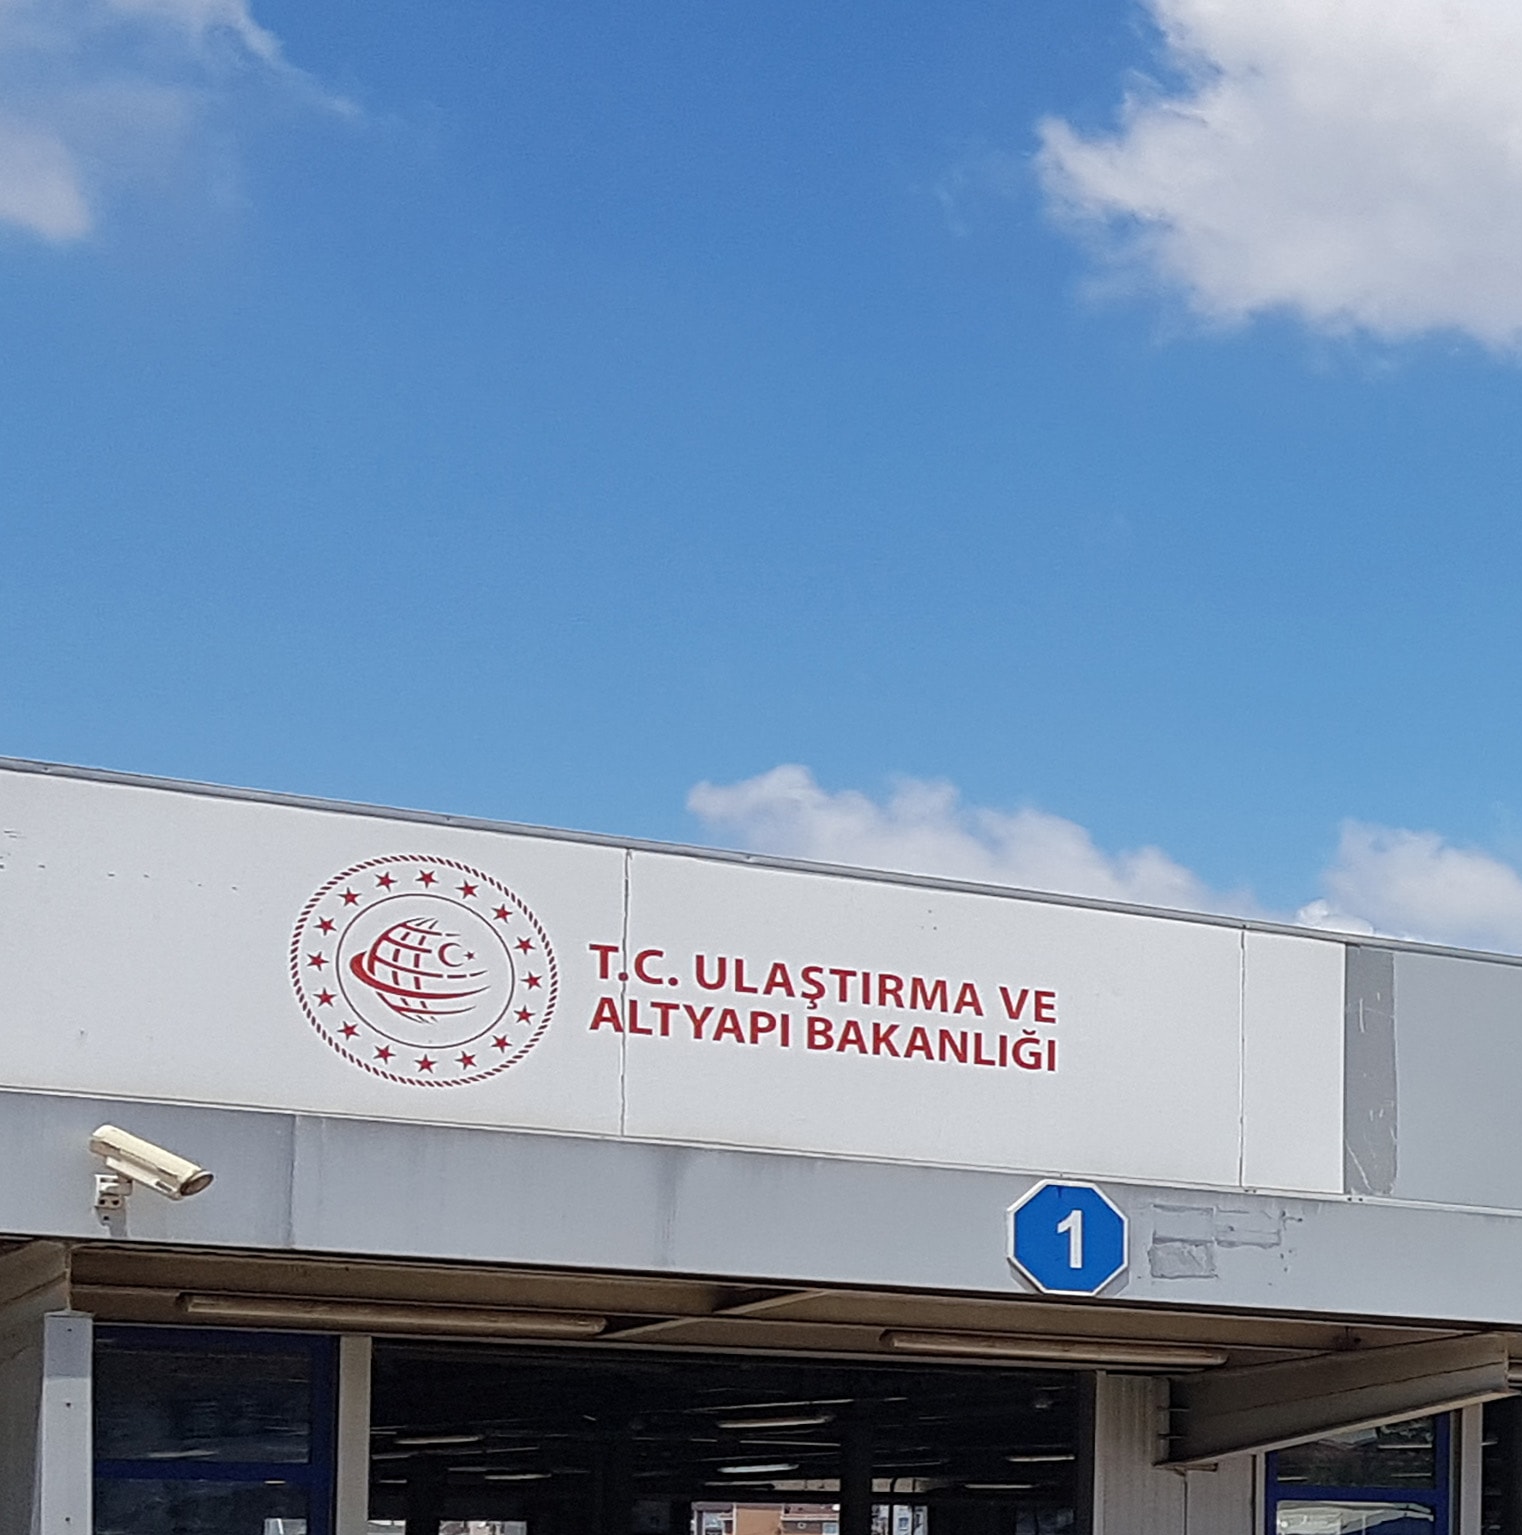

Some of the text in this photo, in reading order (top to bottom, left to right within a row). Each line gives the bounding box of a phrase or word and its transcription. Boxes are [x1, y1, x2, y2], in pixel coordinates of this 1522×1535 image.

[588, 943, 1058, 1025] T.C. ULAŞTIRMA VE
[588, 996, 1058, 1073] ALTYAPI BAKANLIĞI
[1056, 1209, 1083, 1269] 1
